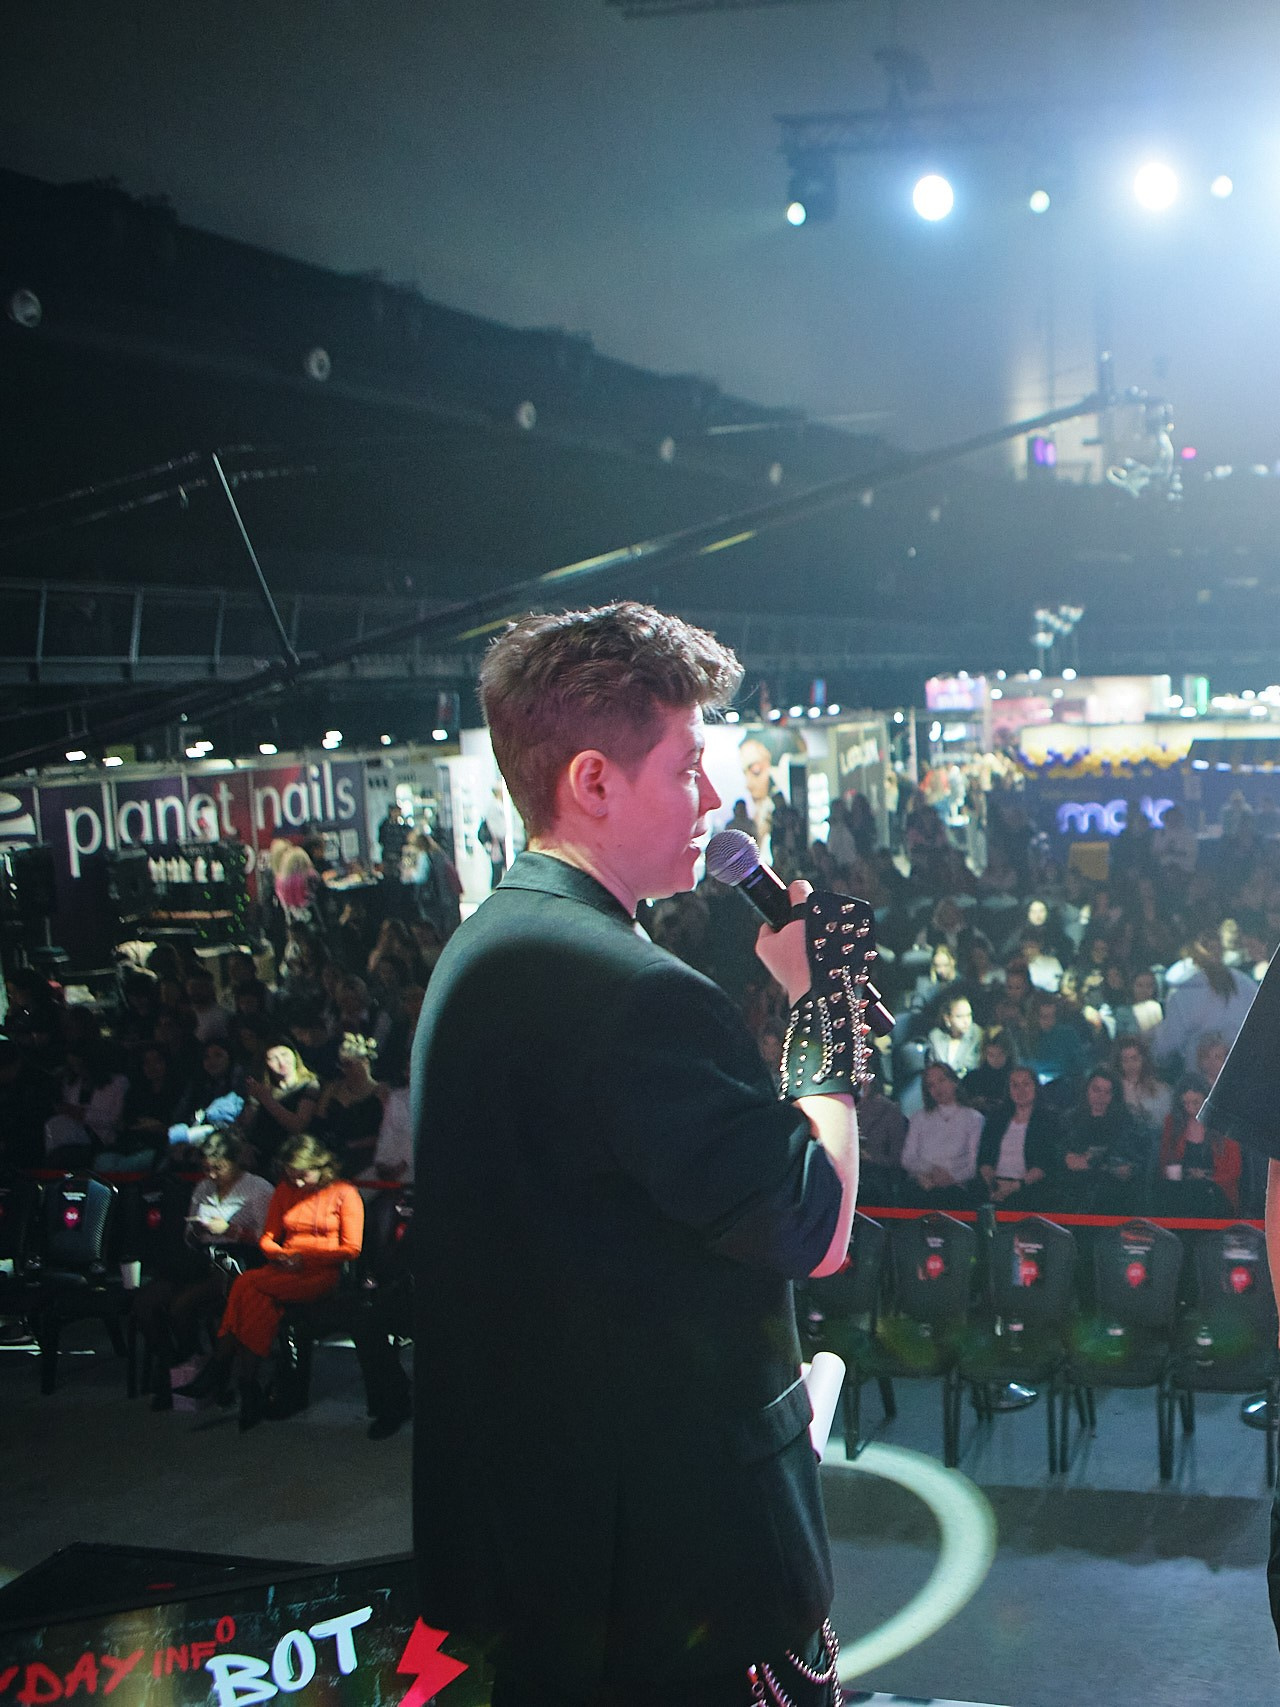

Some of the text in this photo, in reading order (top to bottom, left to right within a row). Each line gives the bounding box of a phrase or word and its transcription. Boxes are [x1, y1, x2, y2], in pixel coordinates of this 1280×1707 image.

[64, 758, 357, 879] planet nails
[0, 1649, 145, 1705] DAY
[205, 1605, 373, 1707] BOT
